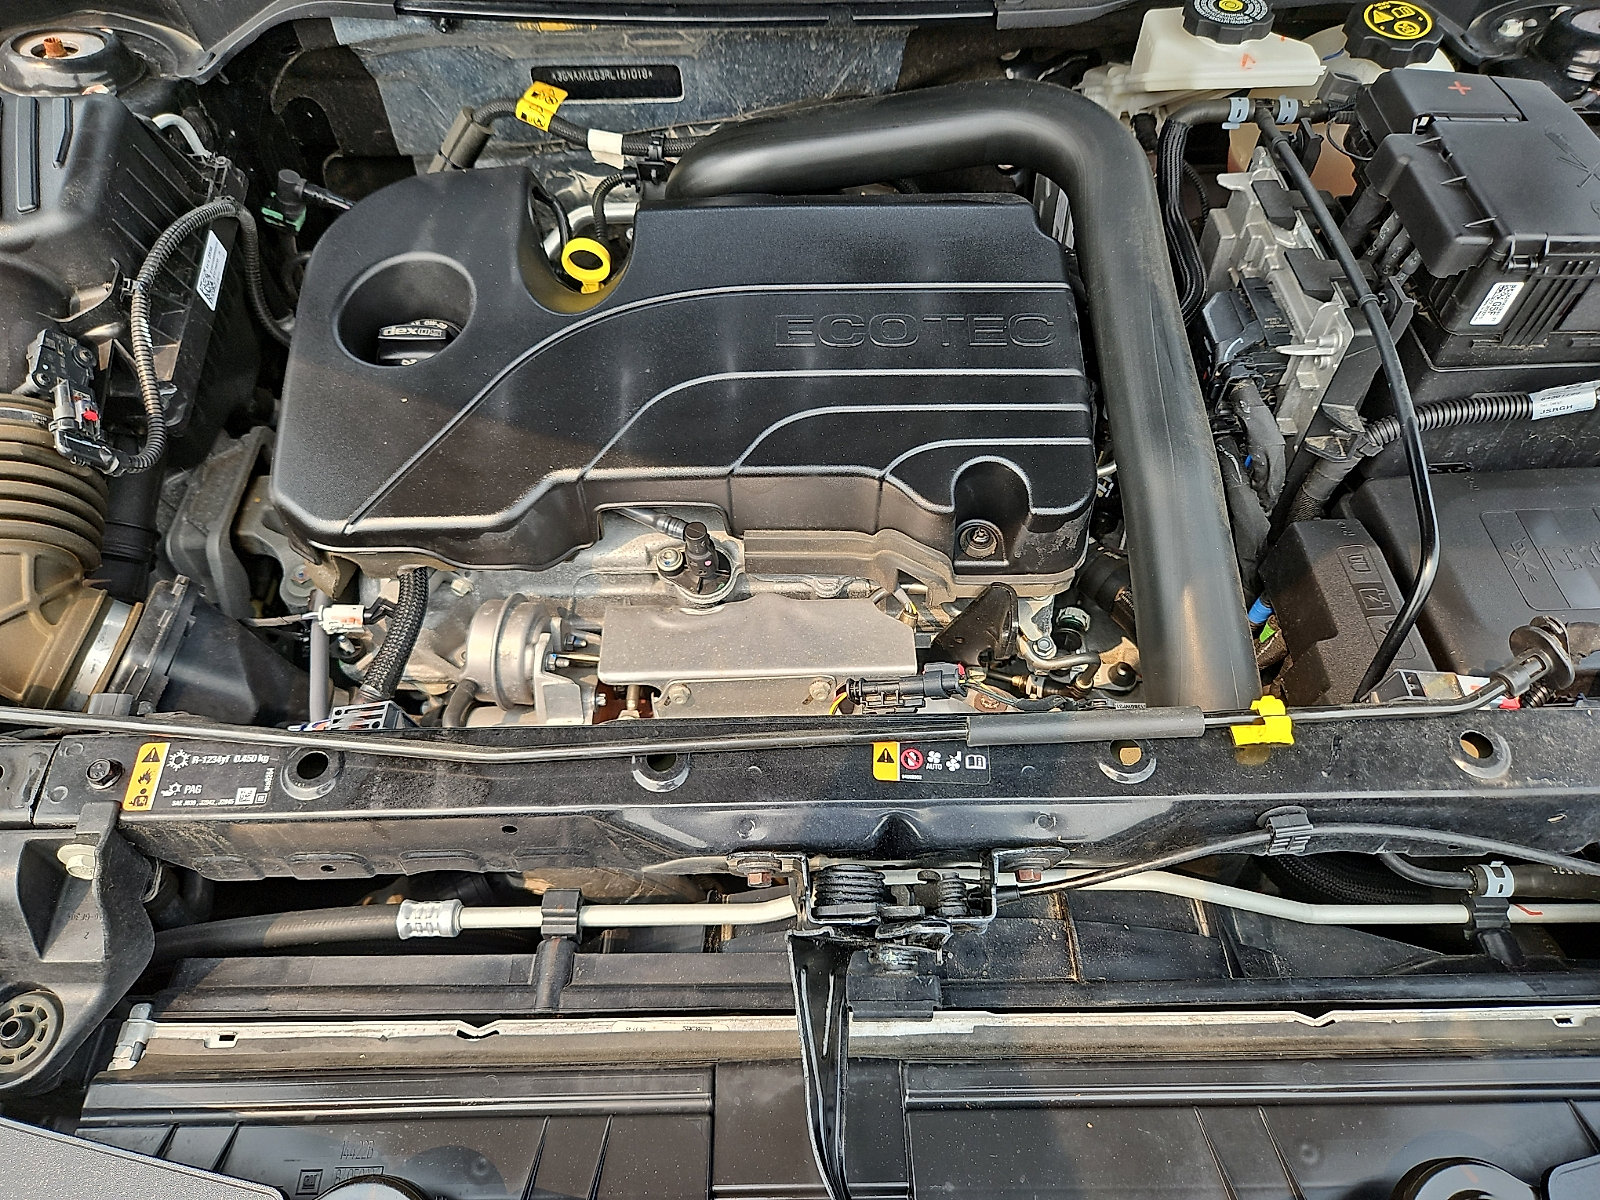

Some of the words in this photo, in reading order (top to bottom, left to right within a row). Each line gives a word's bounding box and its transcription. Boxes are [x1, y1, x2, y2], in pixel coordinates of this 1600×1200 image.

[383, 325, 443, 338] dexos
[775, 313, 1056, 347] ECOTEC
[191, 754, 231, 766] R-1234yf
[233, 754, 257, 764] 0.450
[257, 753, 270, 765] kg
[925, 763, 943, 771] AUTO
[183, 784, 203, 795] PAG
